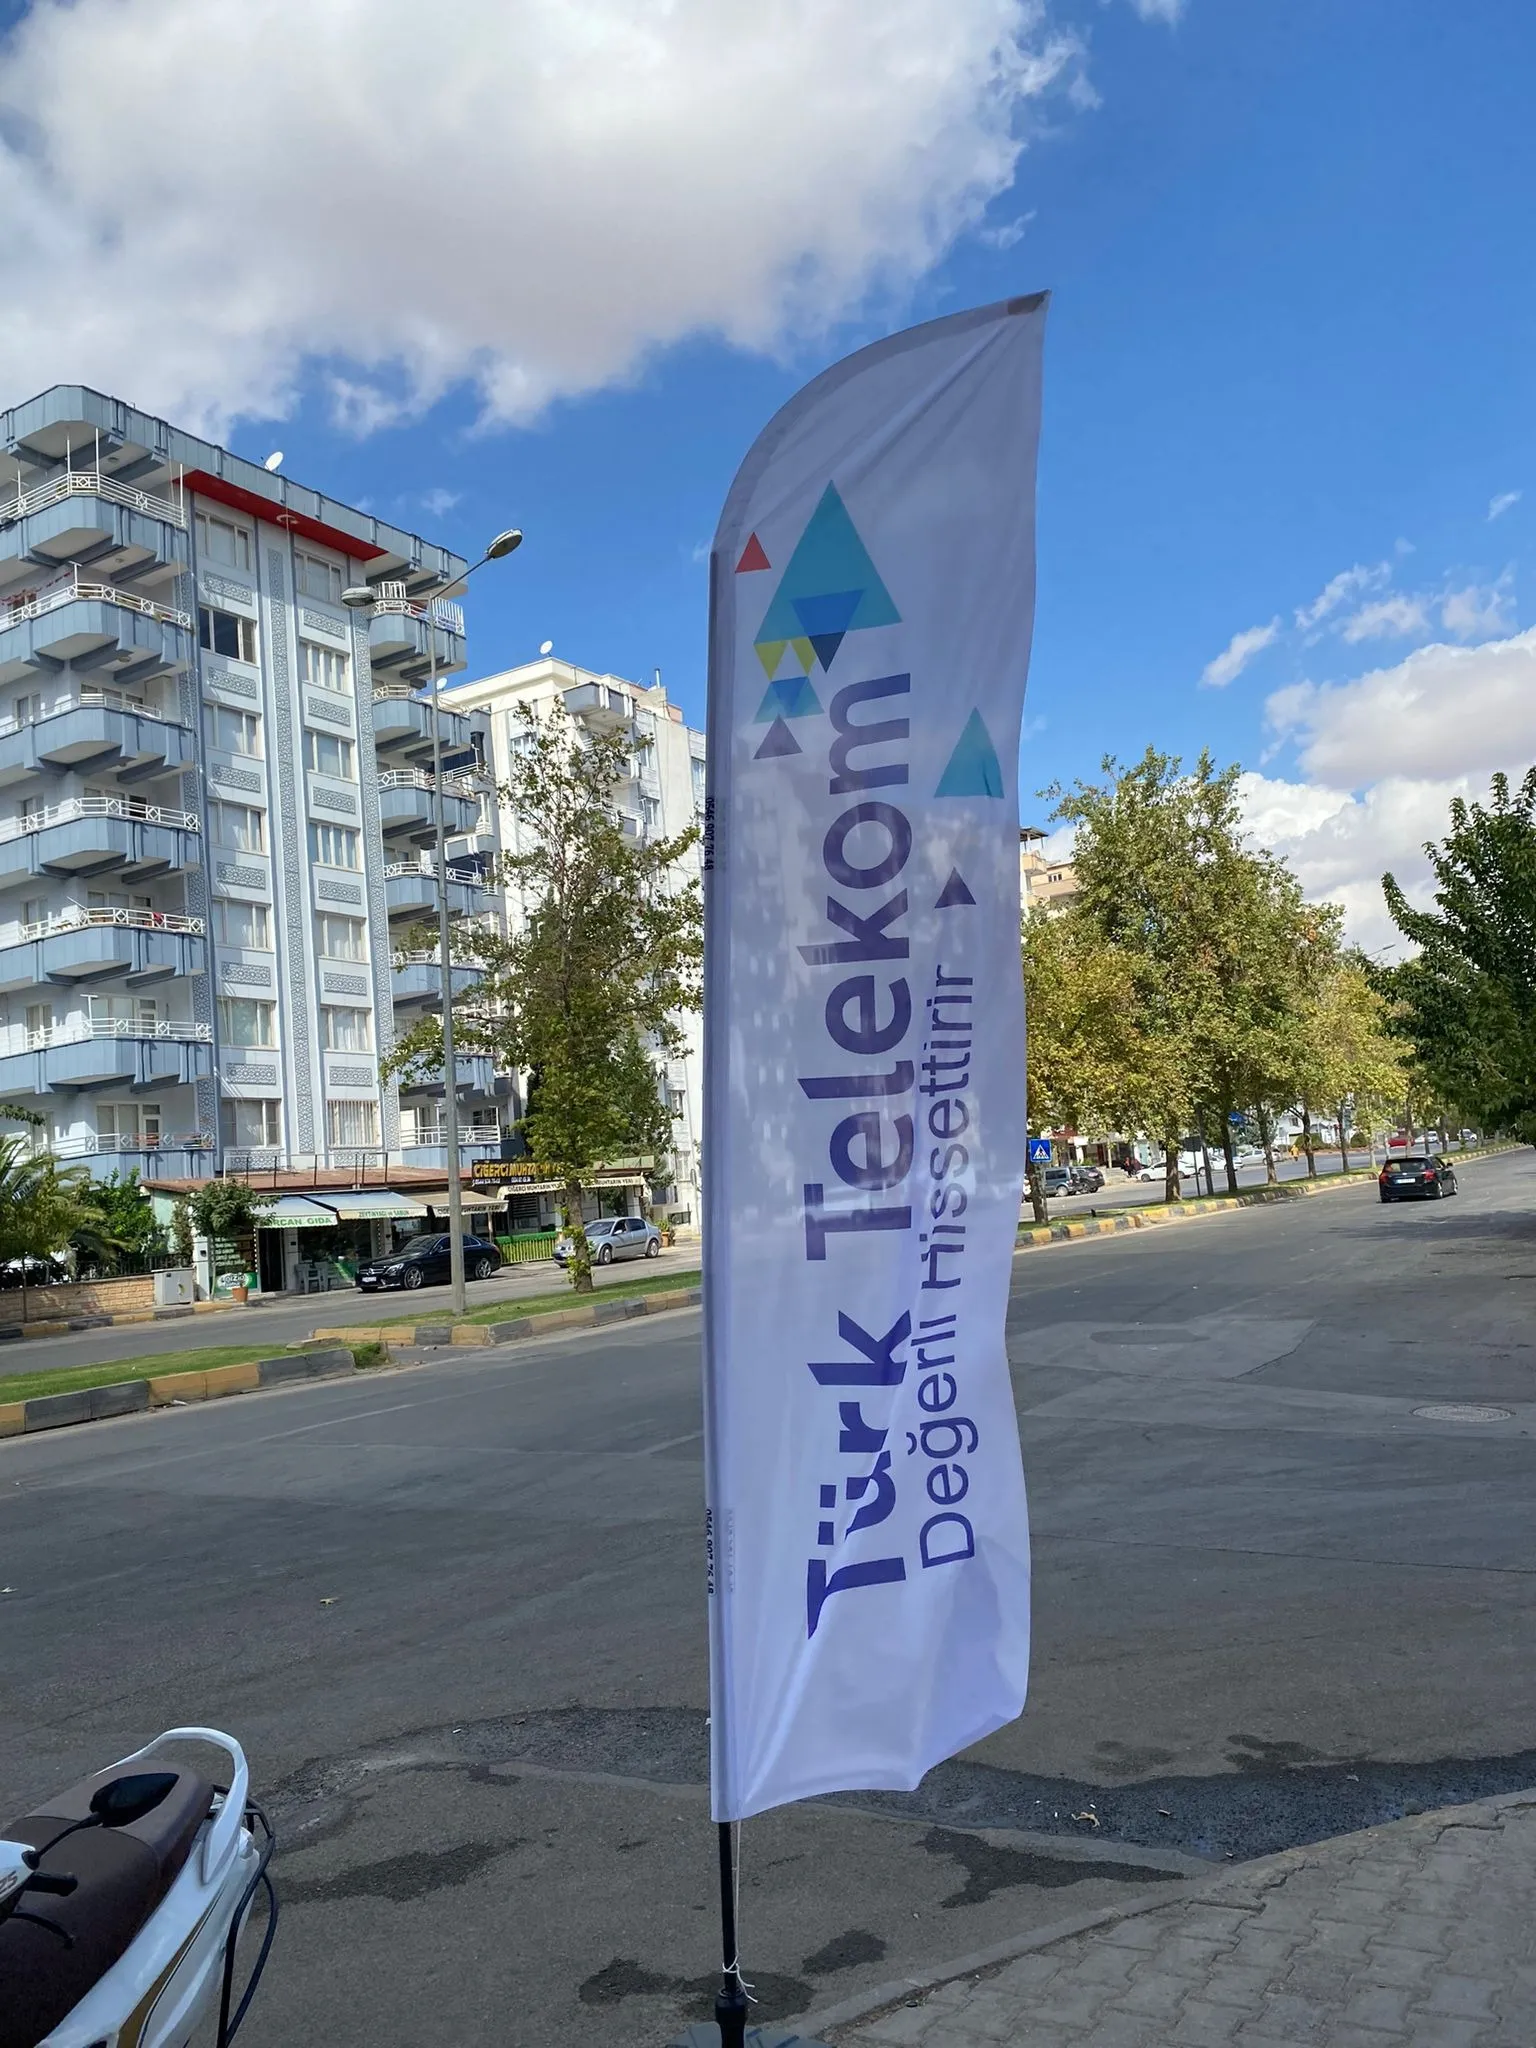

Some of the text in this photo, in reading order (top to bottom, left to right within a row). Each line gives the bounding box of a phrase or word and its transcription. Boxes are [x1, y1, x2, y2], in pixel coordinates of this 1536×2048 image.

[306, 1216, 332, 1225] GIDA
[798, 672, 913, 1639] Türk Telekom
[920, 963, 974, 1290] Hissettirir
